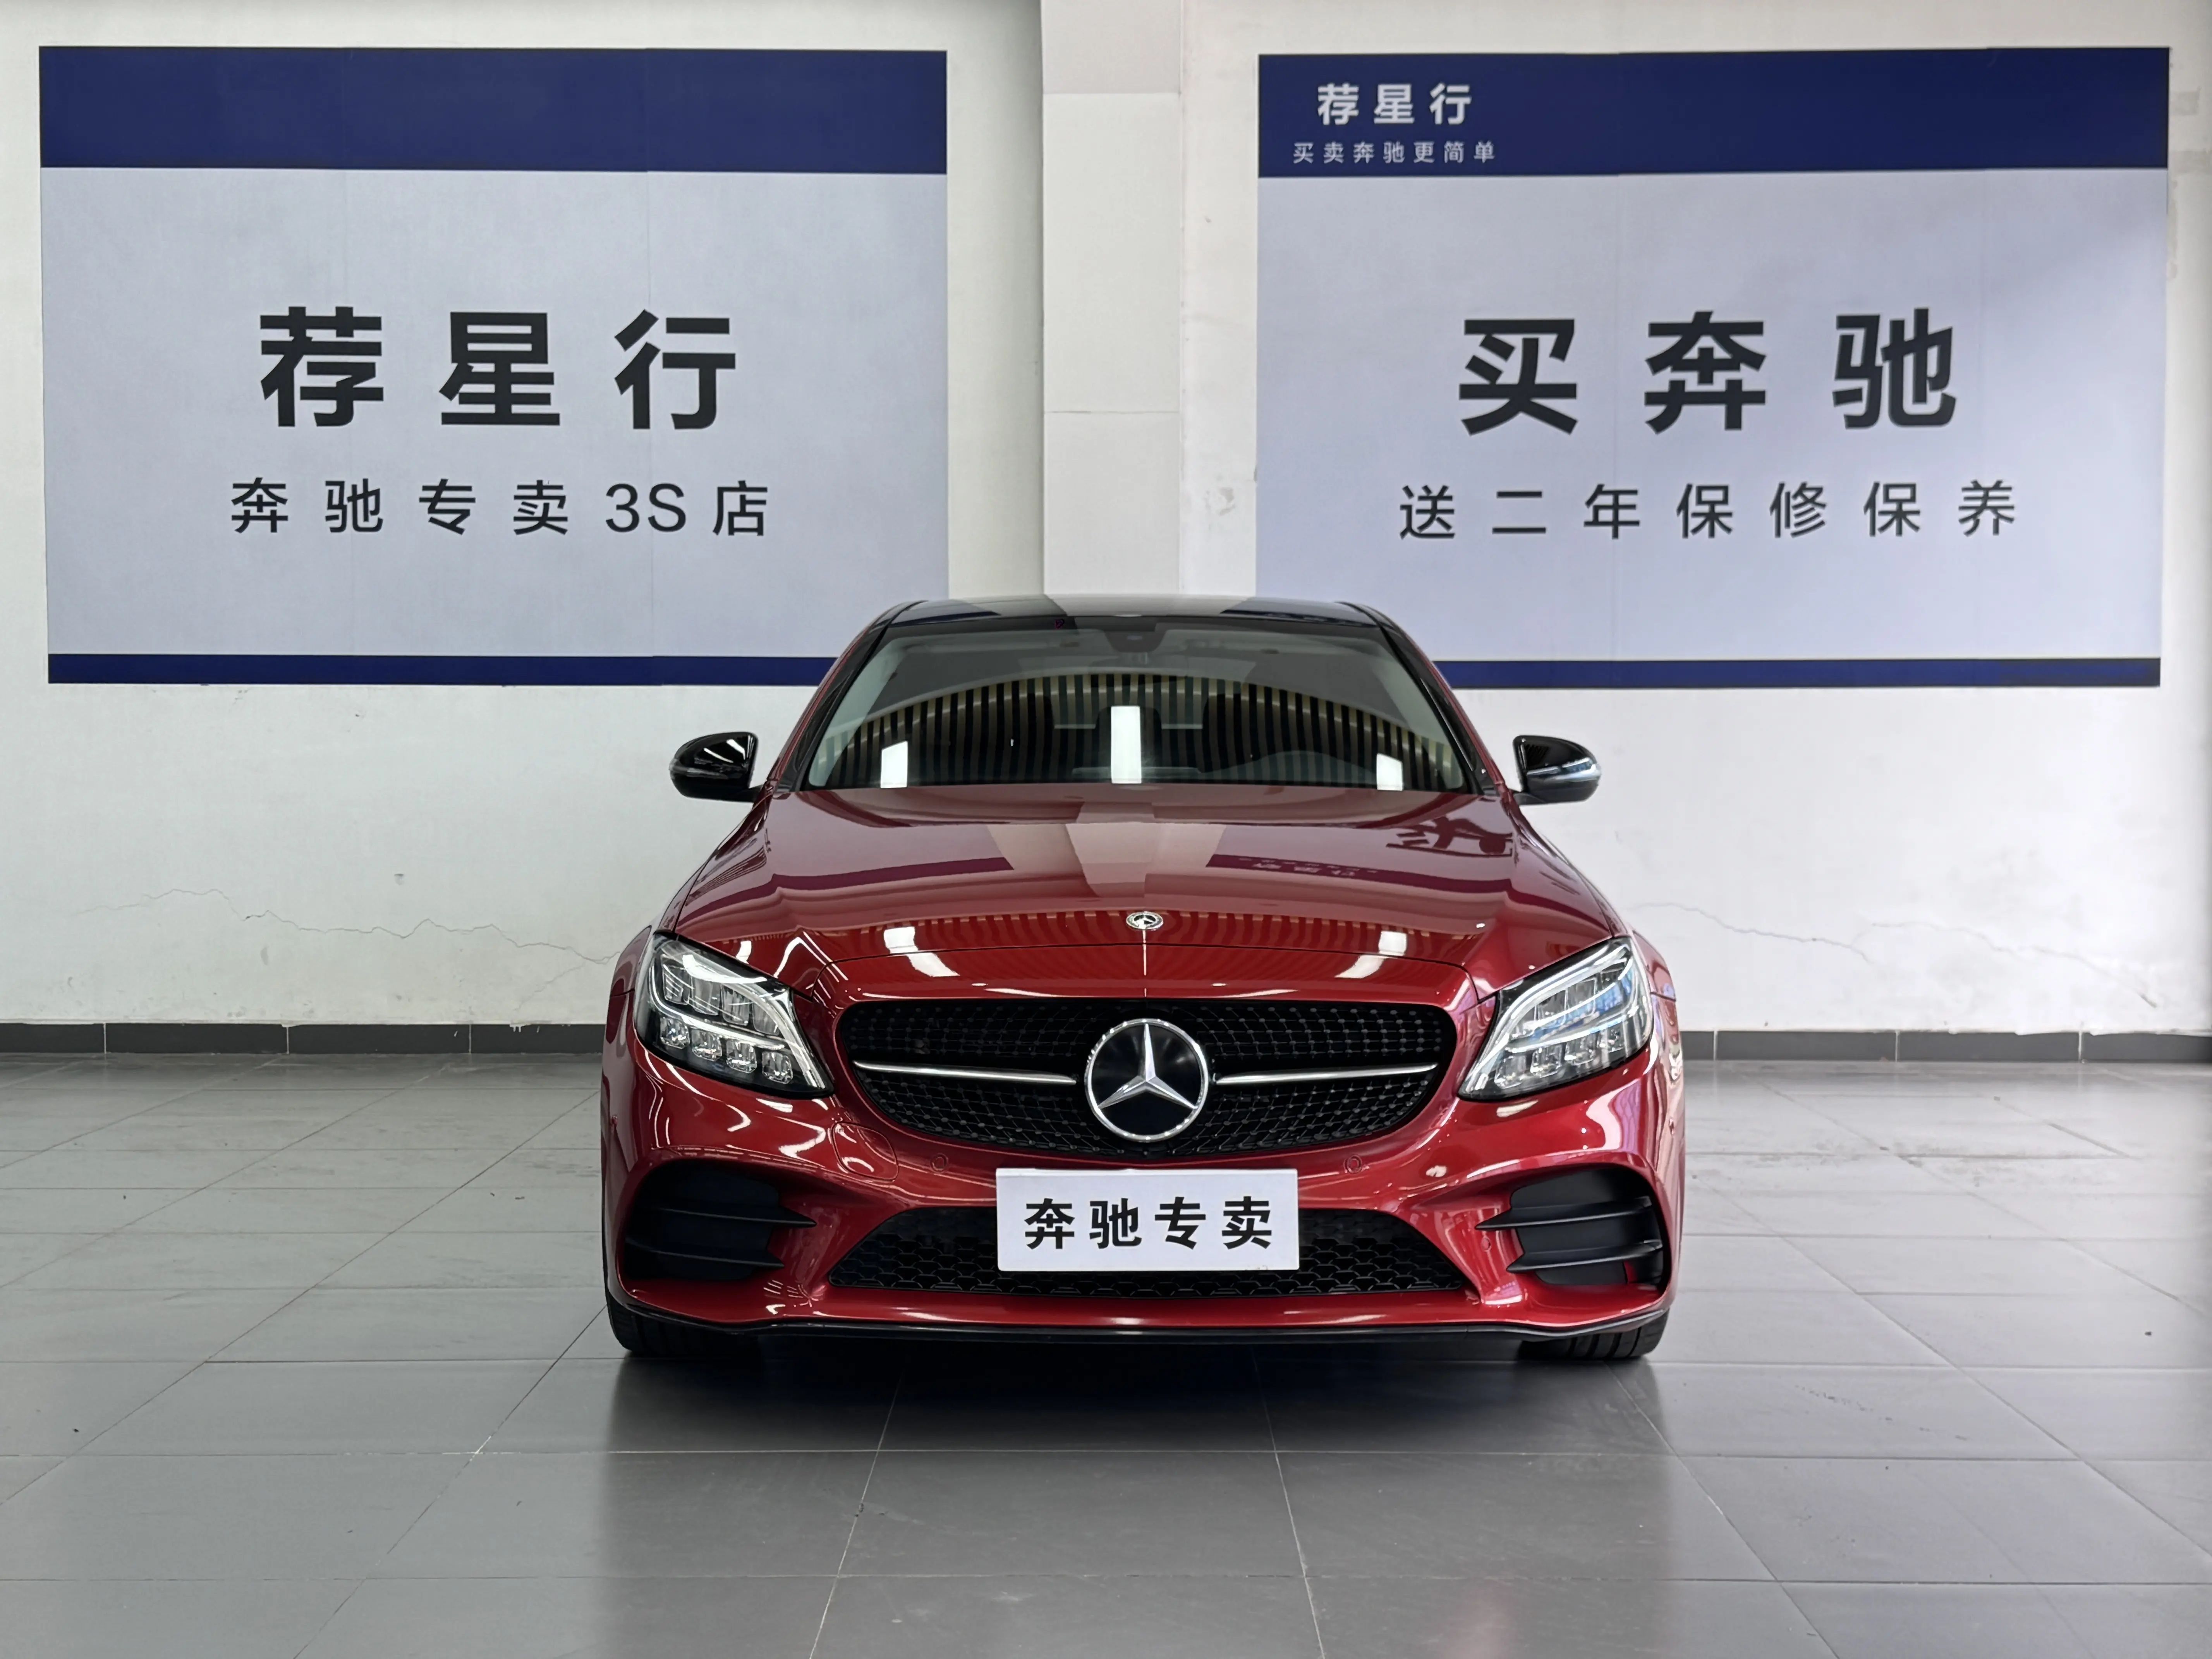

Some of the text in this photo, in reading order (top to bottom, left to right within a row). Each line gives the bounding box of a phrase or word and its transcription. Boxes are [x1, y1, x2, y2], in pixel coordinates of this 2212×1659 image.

[1317, 82, 1472, 126] 荐星行
[1293, 141, 1495, 164] 买卖奔驰更简单
[259, 306, 736, 430] 荐星行
[1458, 307, 1956, 436] 买奔驰
[231, 477, 768, 536] 奔驰专卖3S店
[1399, 480, 2015, 540] 送二年保修保养
[1024, 1195, 1272, 1250] 奔驰专卖
